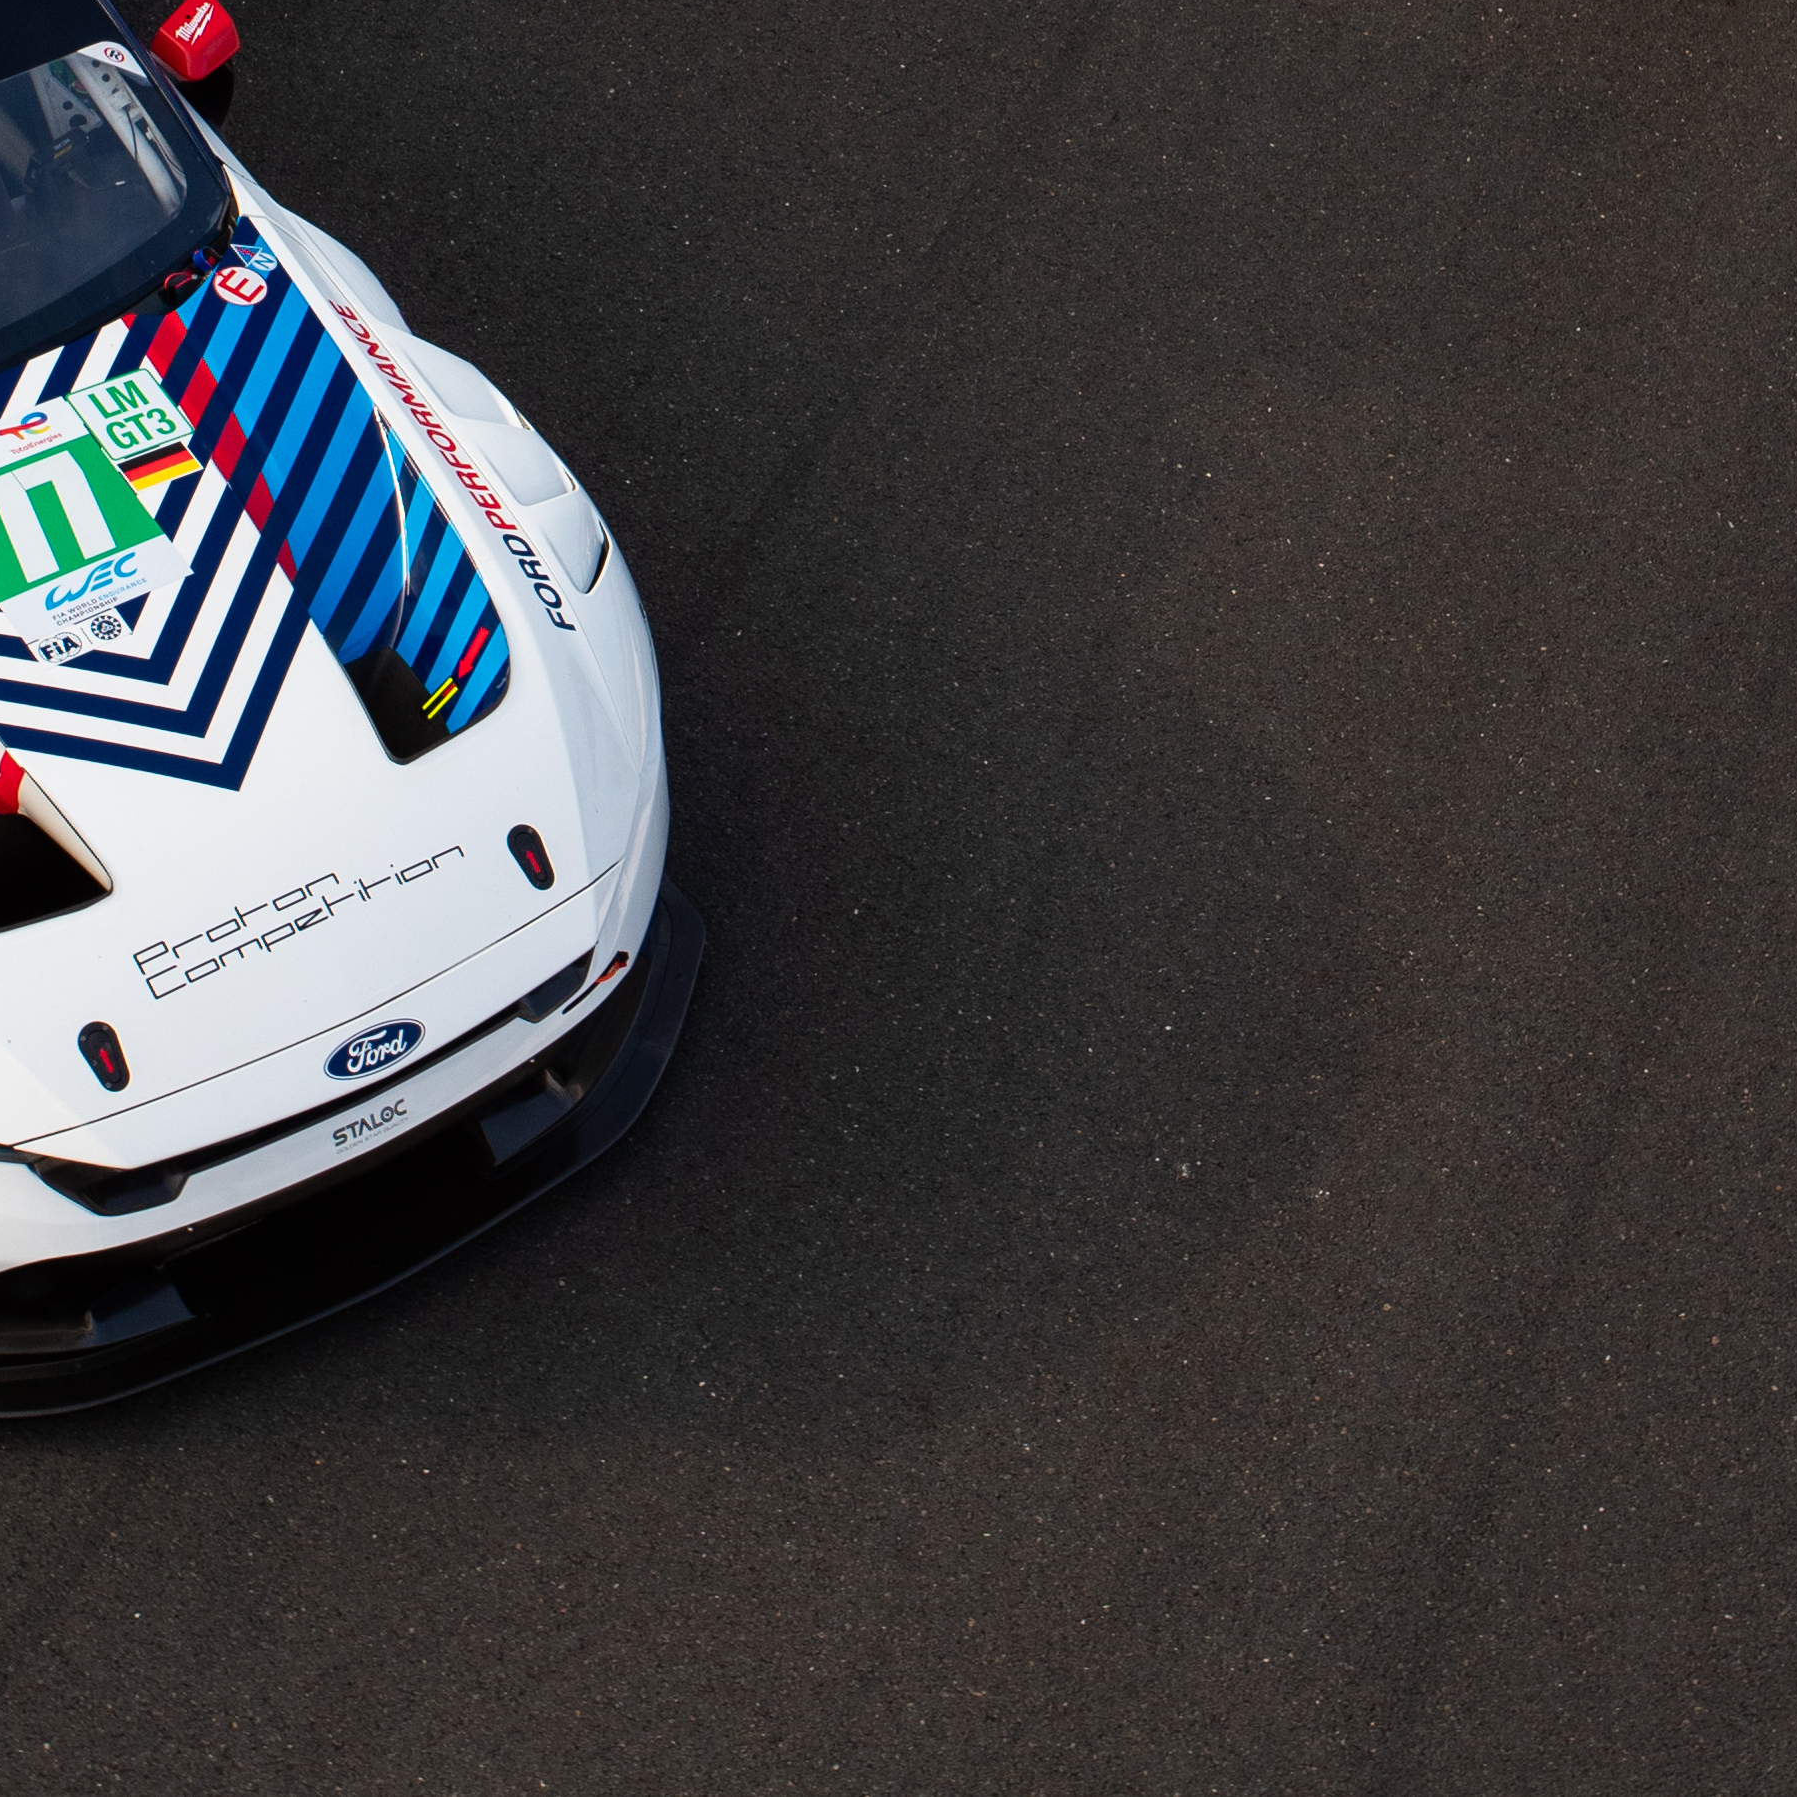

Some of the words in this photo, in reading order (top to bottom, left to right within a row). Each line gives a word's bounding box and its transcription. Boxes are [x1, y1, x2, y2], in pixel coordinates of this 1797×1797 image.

[219, 269, 265, 304] E
[89, 380, 150, 419] LM
[10, 432, 64, 456] TotalEnergies
[106, 407, 177, 450] GT3
[44, 551, 139, 611] WEC
[52, 611, 66, 622] FIA
[67, 597, 98, 615] WORLD
[97, 576, 148, 602] ENDURANCE
[56, 595, 120, 627] CHAMPIONSHIP
[133, 873, 340, 975] Proton
[146, 845, 465, 1000] Competition
[345, 1028, 408, 1075] Ford
[332, 1097, 407, 1147] STALOC
